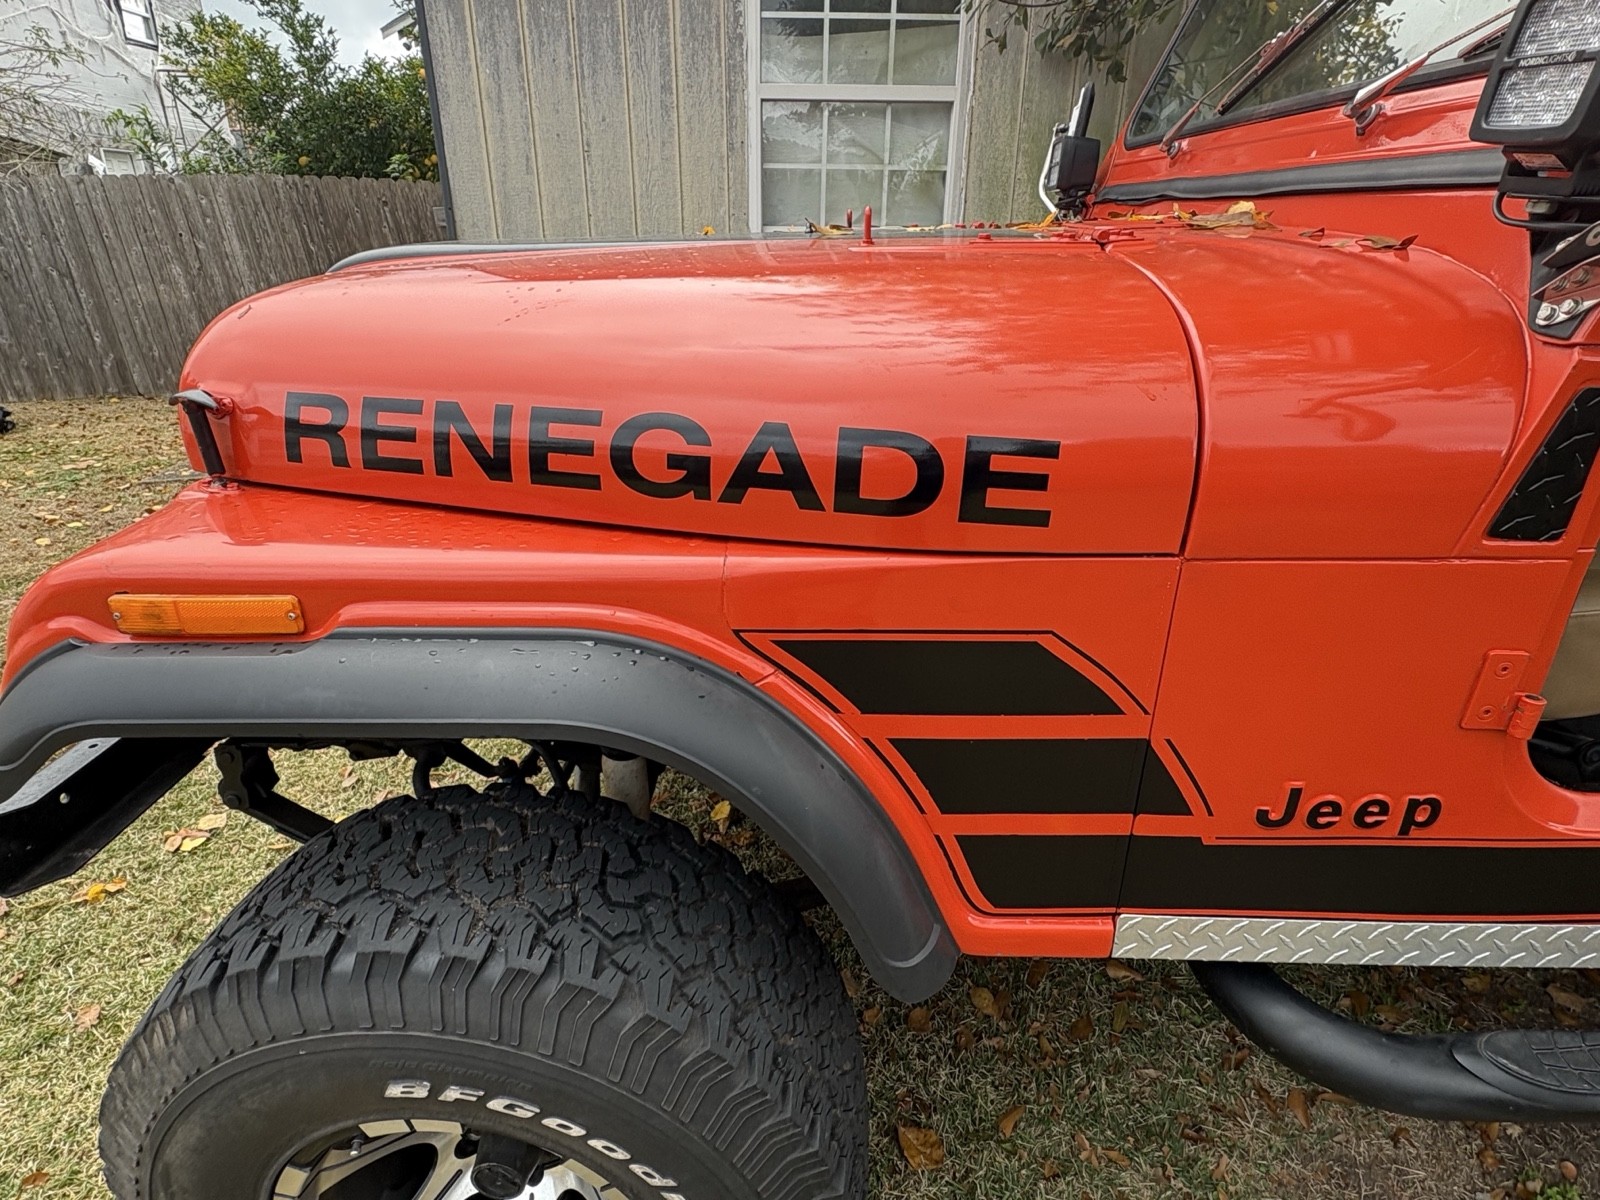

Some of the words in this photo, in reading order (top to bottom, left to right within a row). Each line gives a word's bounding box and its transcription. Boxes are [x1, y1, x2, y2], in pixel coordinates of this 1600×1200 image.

[284, 391, 1062, 528] RENEGADE
[1255, 782, 1443, 837] Jeep
[384, 1079, 686, 1200] BFGood
